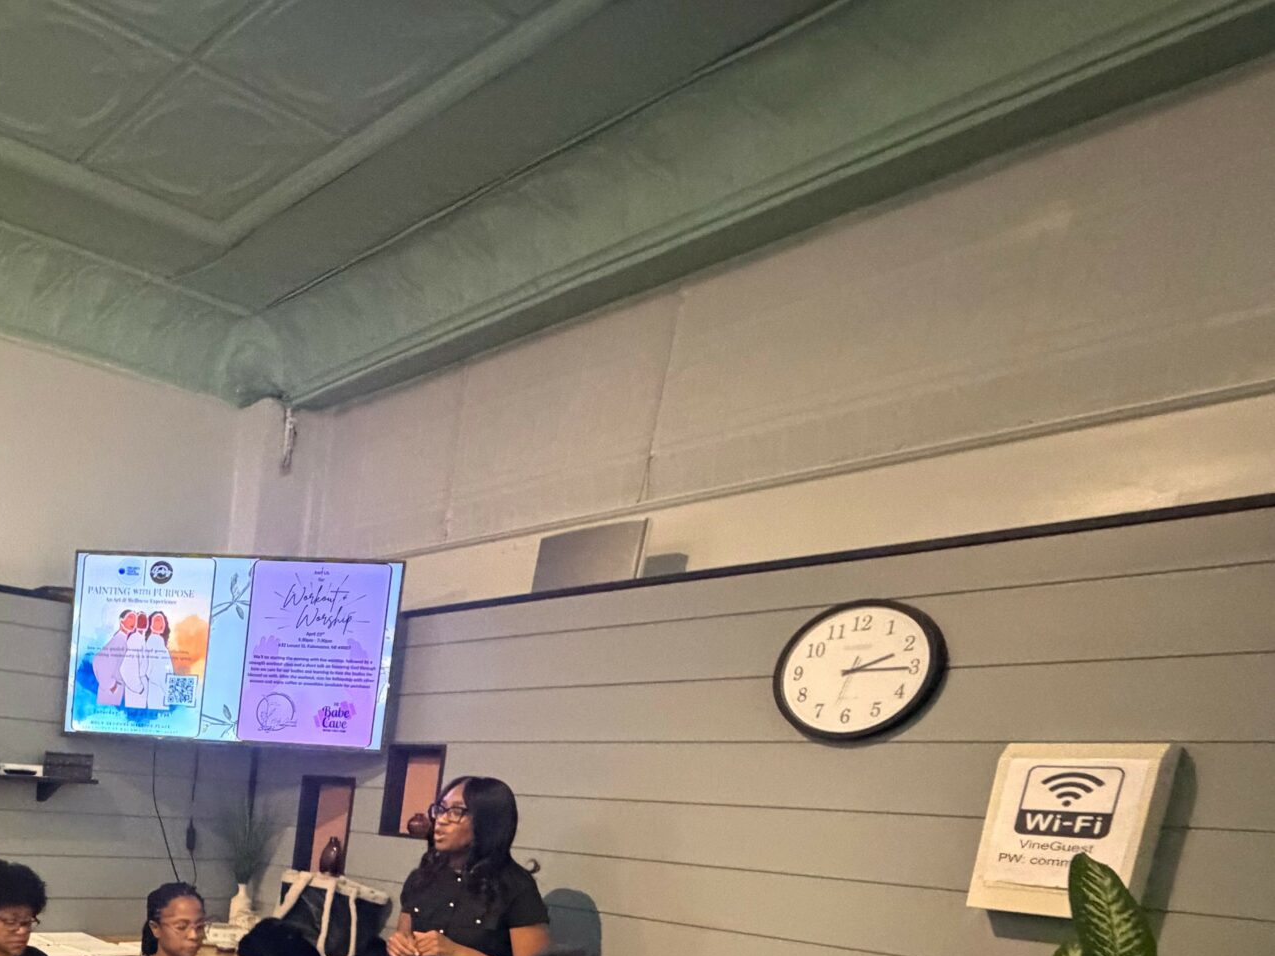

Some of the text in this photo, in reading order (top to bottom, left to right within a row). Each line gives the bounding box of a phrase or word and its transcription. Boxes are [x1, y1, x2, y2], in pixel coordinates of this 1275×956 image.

[87, 585, 131, 596] PAINTING
[153, 588, 195, 599] PURPOSE
[283, 582, 350, 612] Workout
[296, 605, 354, 635] Worship
[851, 614, 874, 633] 12
[886, 620, 896, 636] 1
[826, 624, 846, 641] 11
[806, 641, 826, 659] 10
[903, 635, 916, 652] 2
[793, 665, 804, 682] 9
[908, 658, 921, 675] 3
[796, 686, 808, 703] 8
[893, 683, 906, 700] 4
[322, 706, 350, 719] Babe
[813, 703, 824, 719] 7
[840, 708, 851, 724] 6
[870, 702, 883, 718] 5
[322, 717, 348, 730] Cave
[1025, 812, 1103, 835] Wi-Fi
[1019, 838, 1094, 854] VineGuest
[998, 852, 1071, 868] PW: comm
